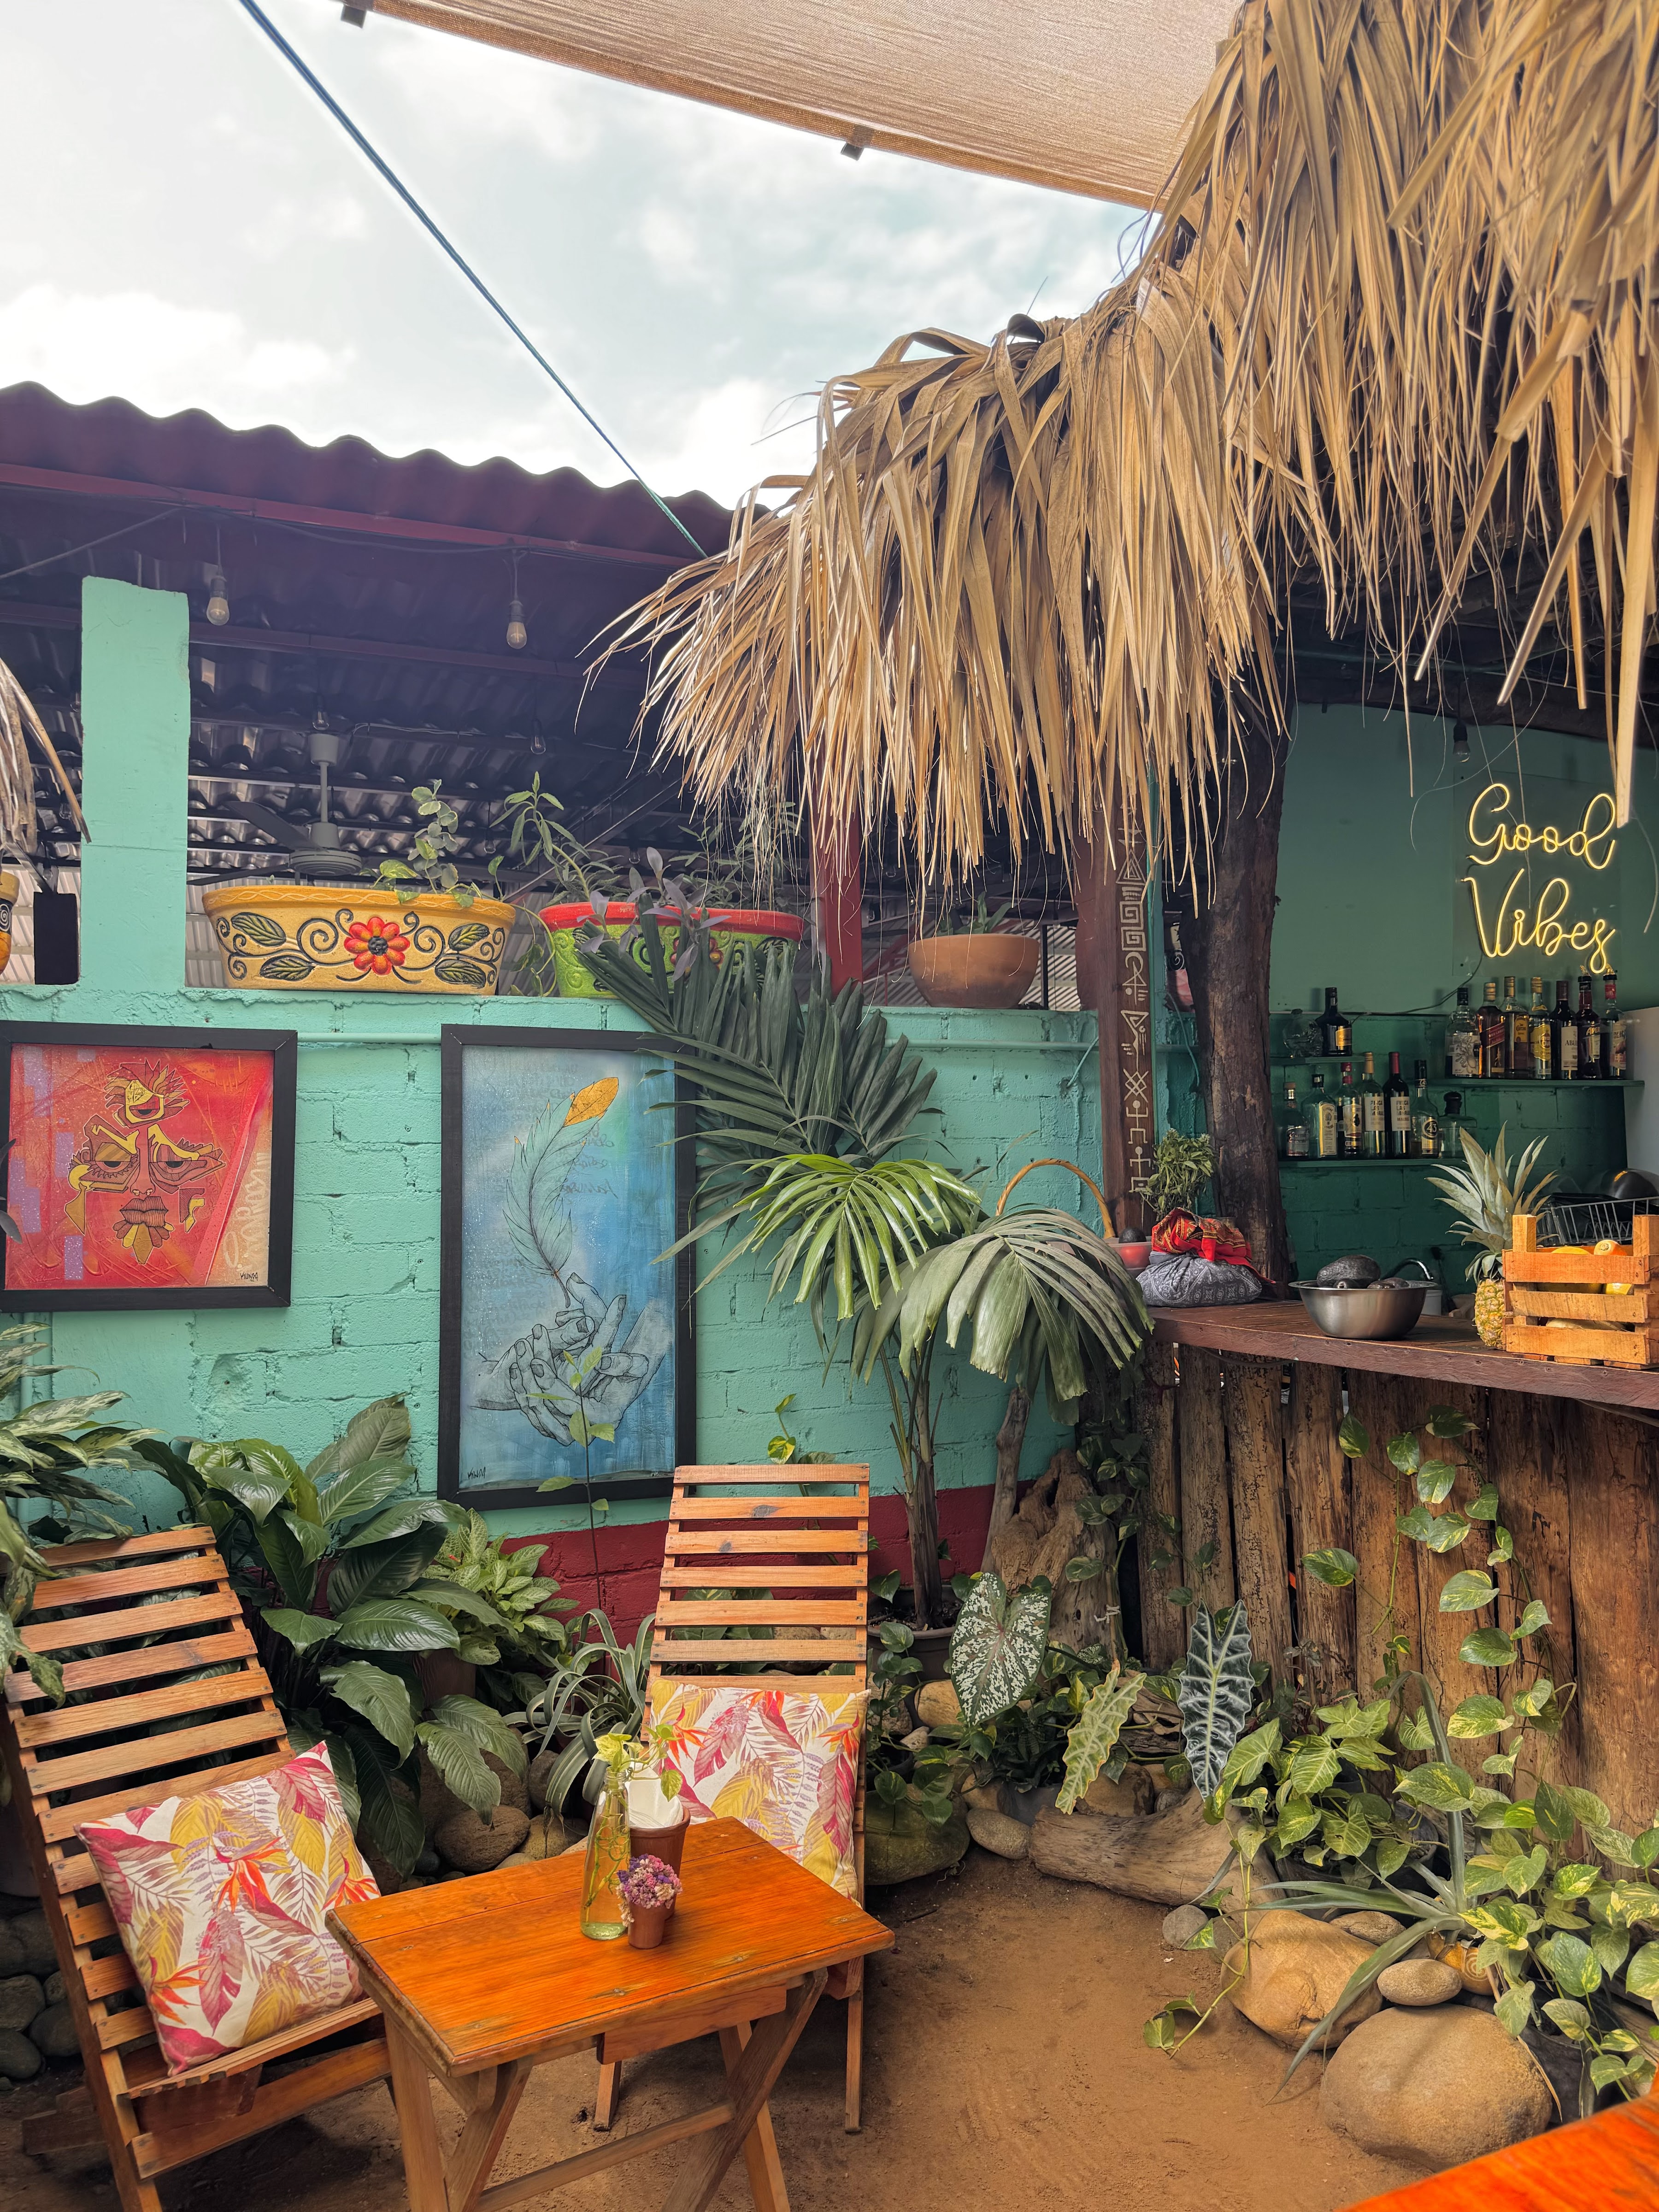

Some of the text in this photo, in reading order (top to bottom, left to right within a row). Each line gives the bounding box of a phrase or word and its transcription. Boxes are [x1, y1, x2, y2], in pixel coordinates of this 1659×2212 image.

[1467, 782, 1616, 870] Good
[1463, 868, 1616, 974] Vibes
[1426, 1122, 1437, 1133] 43
